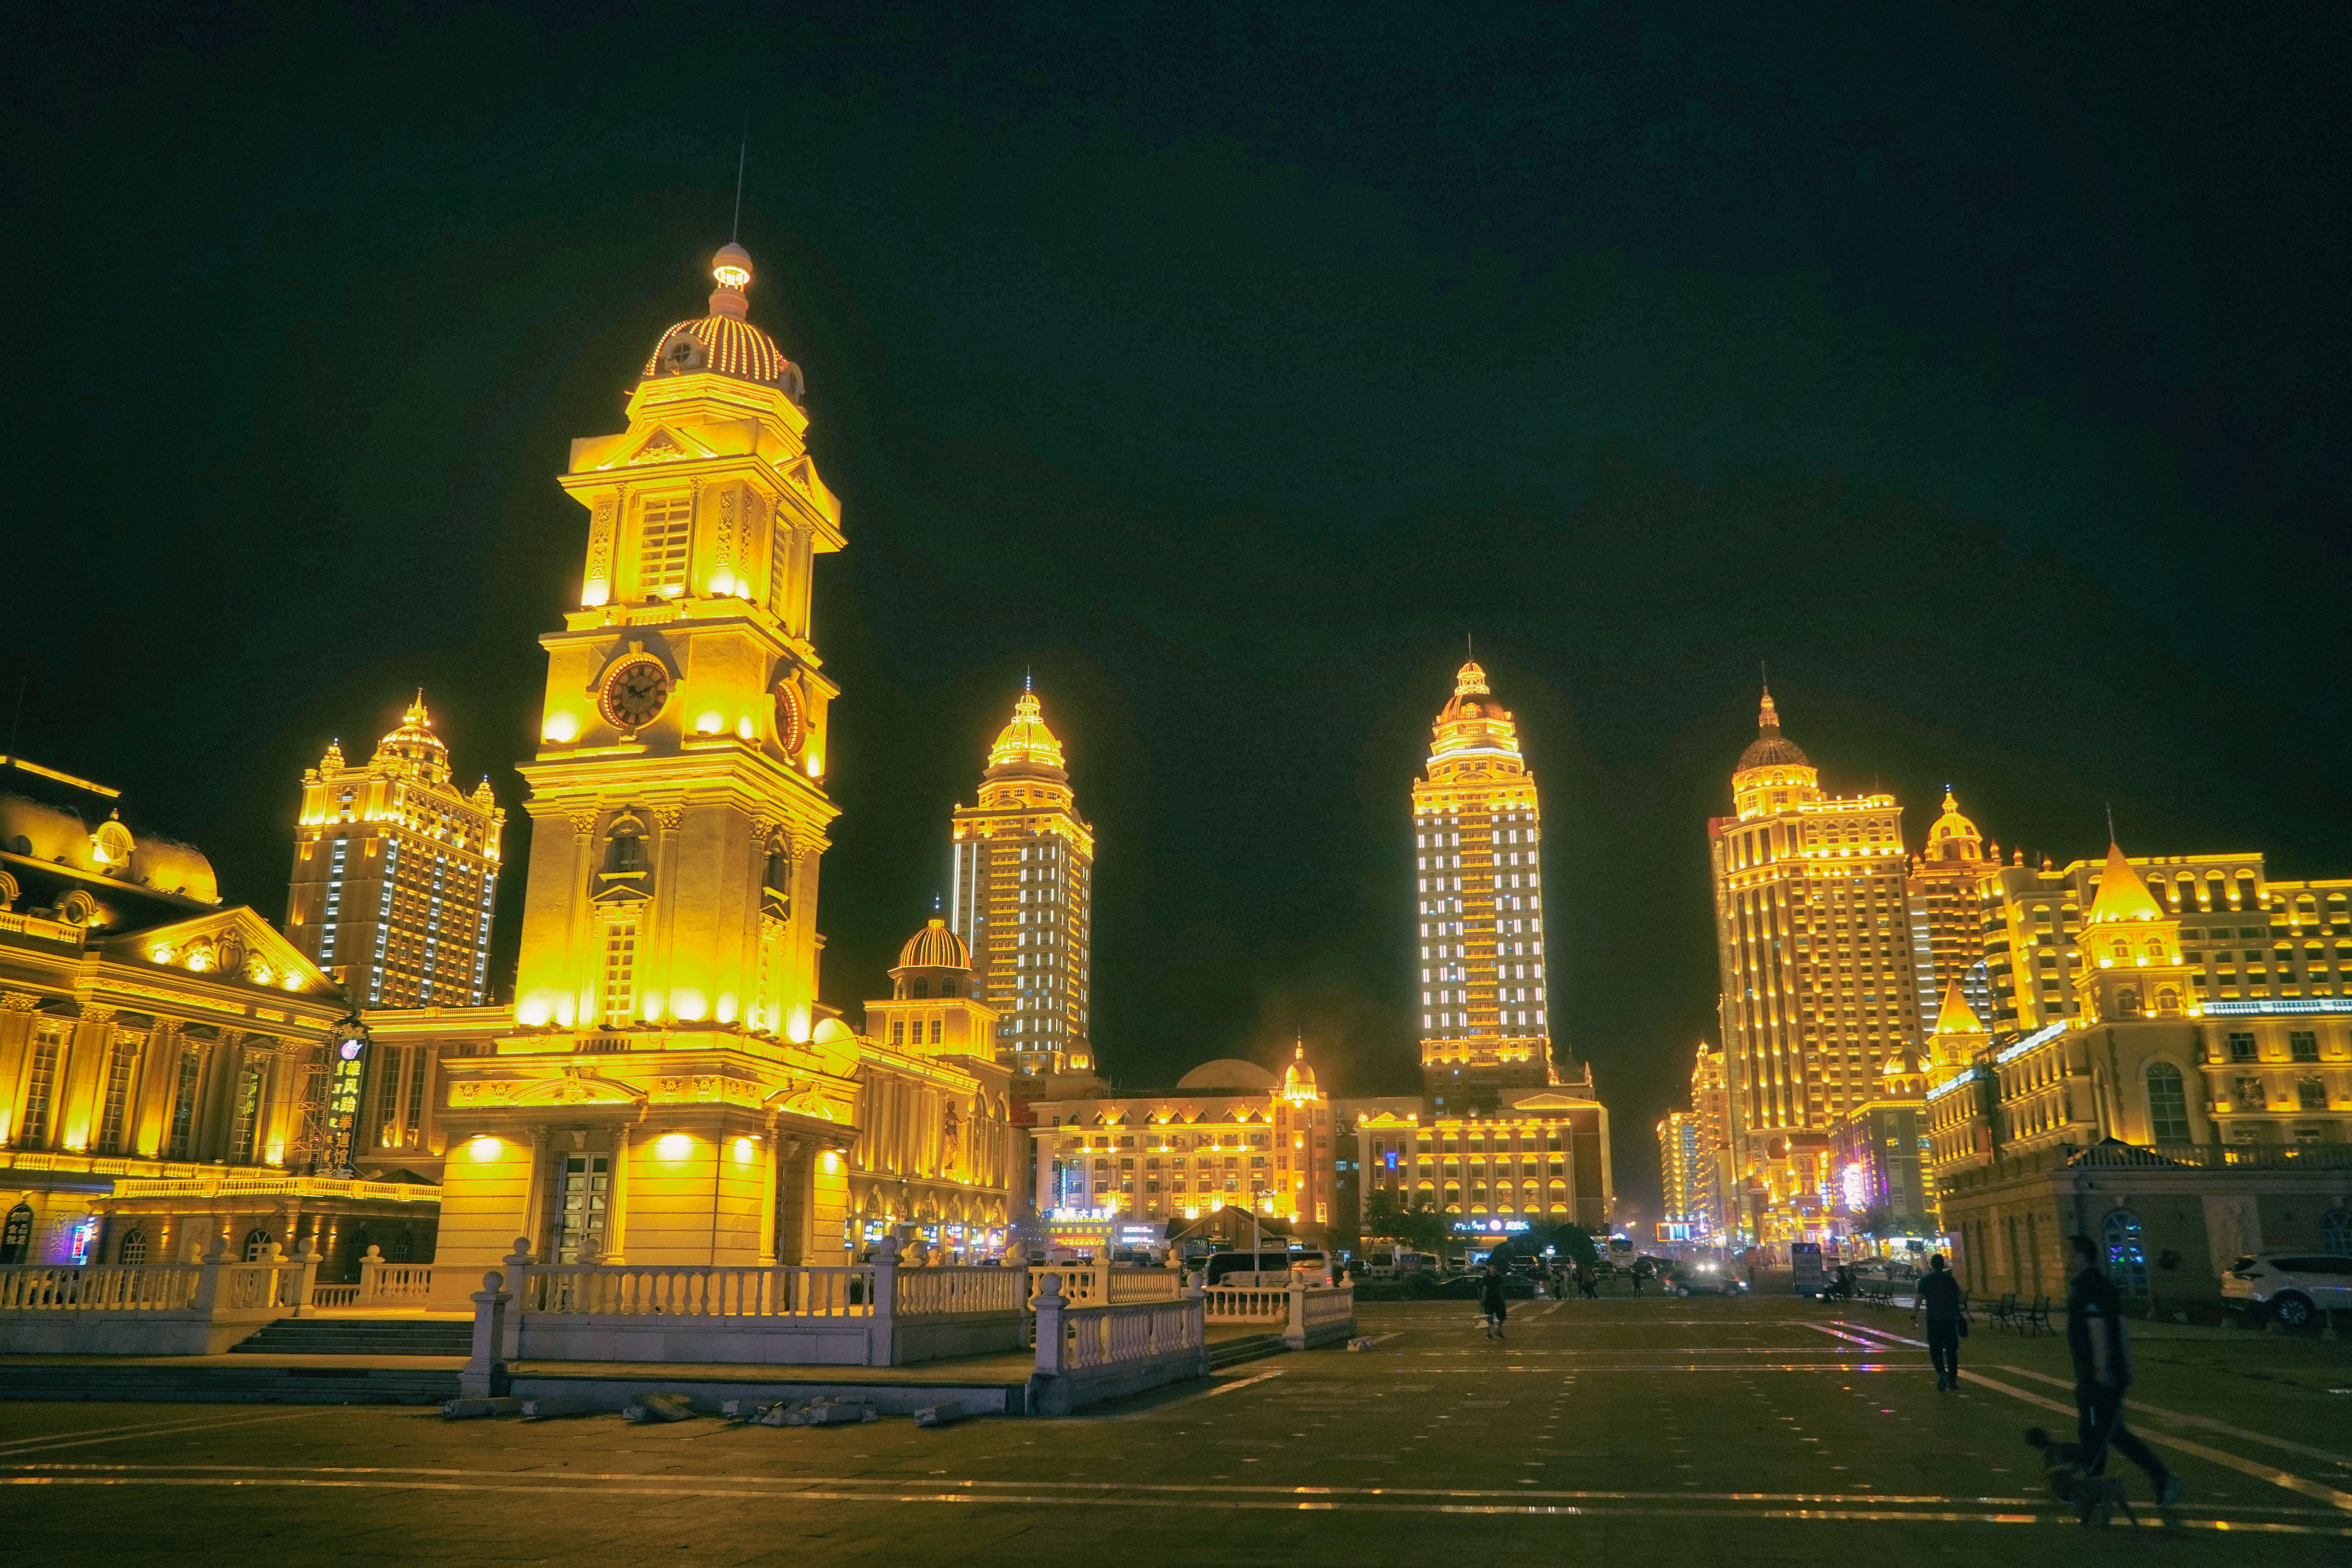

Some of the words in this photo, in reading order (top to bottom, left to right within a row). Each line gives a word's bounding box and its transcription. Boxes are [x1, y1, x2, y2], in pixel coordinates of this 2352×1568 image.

[334, 1060, 361, 1165] 雄风跆拳道馆
